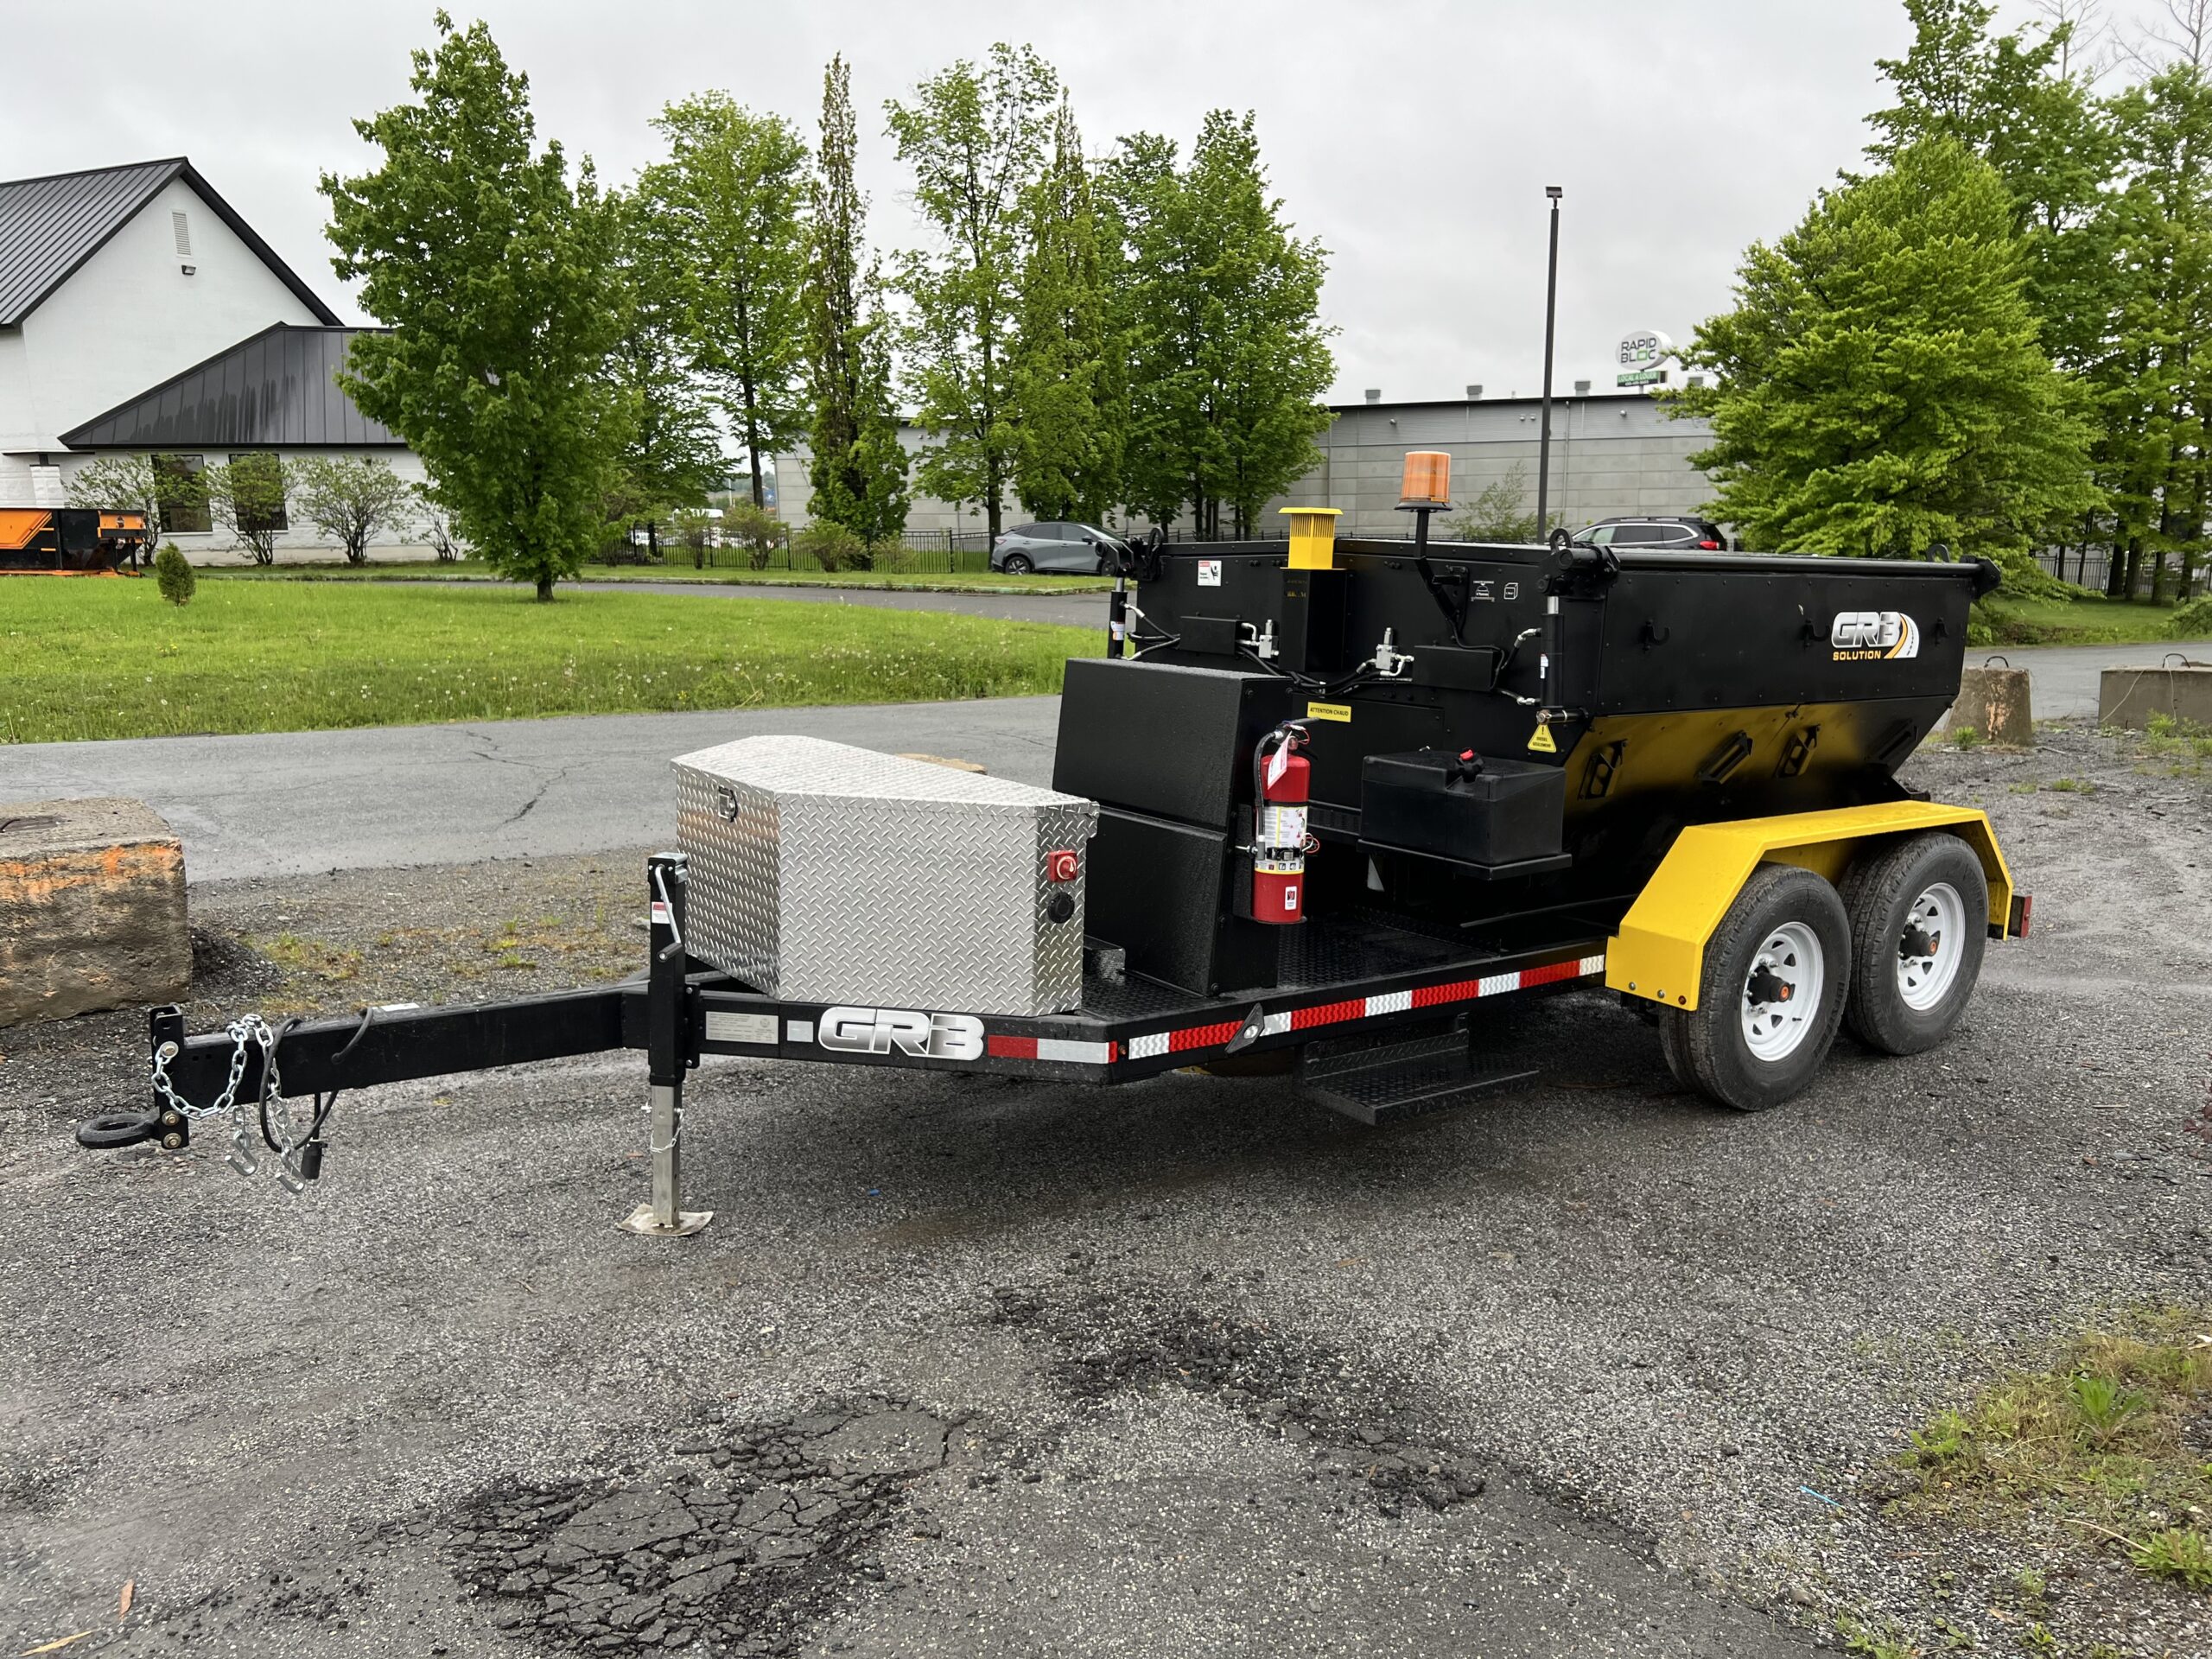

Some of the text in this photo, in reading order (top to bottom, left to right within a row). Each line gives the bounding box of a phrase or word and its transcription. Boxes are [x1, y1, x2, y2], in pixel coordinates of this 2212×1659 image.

[1621, 338, 1656, 352] RAPID
[1621, 349, 1656, 363] BLOC
[1831, 612, 1901, 648] GRB
[1833, 650, 1882, 661] SOLUTION
[818, 1006, 984, 1061] GRB
